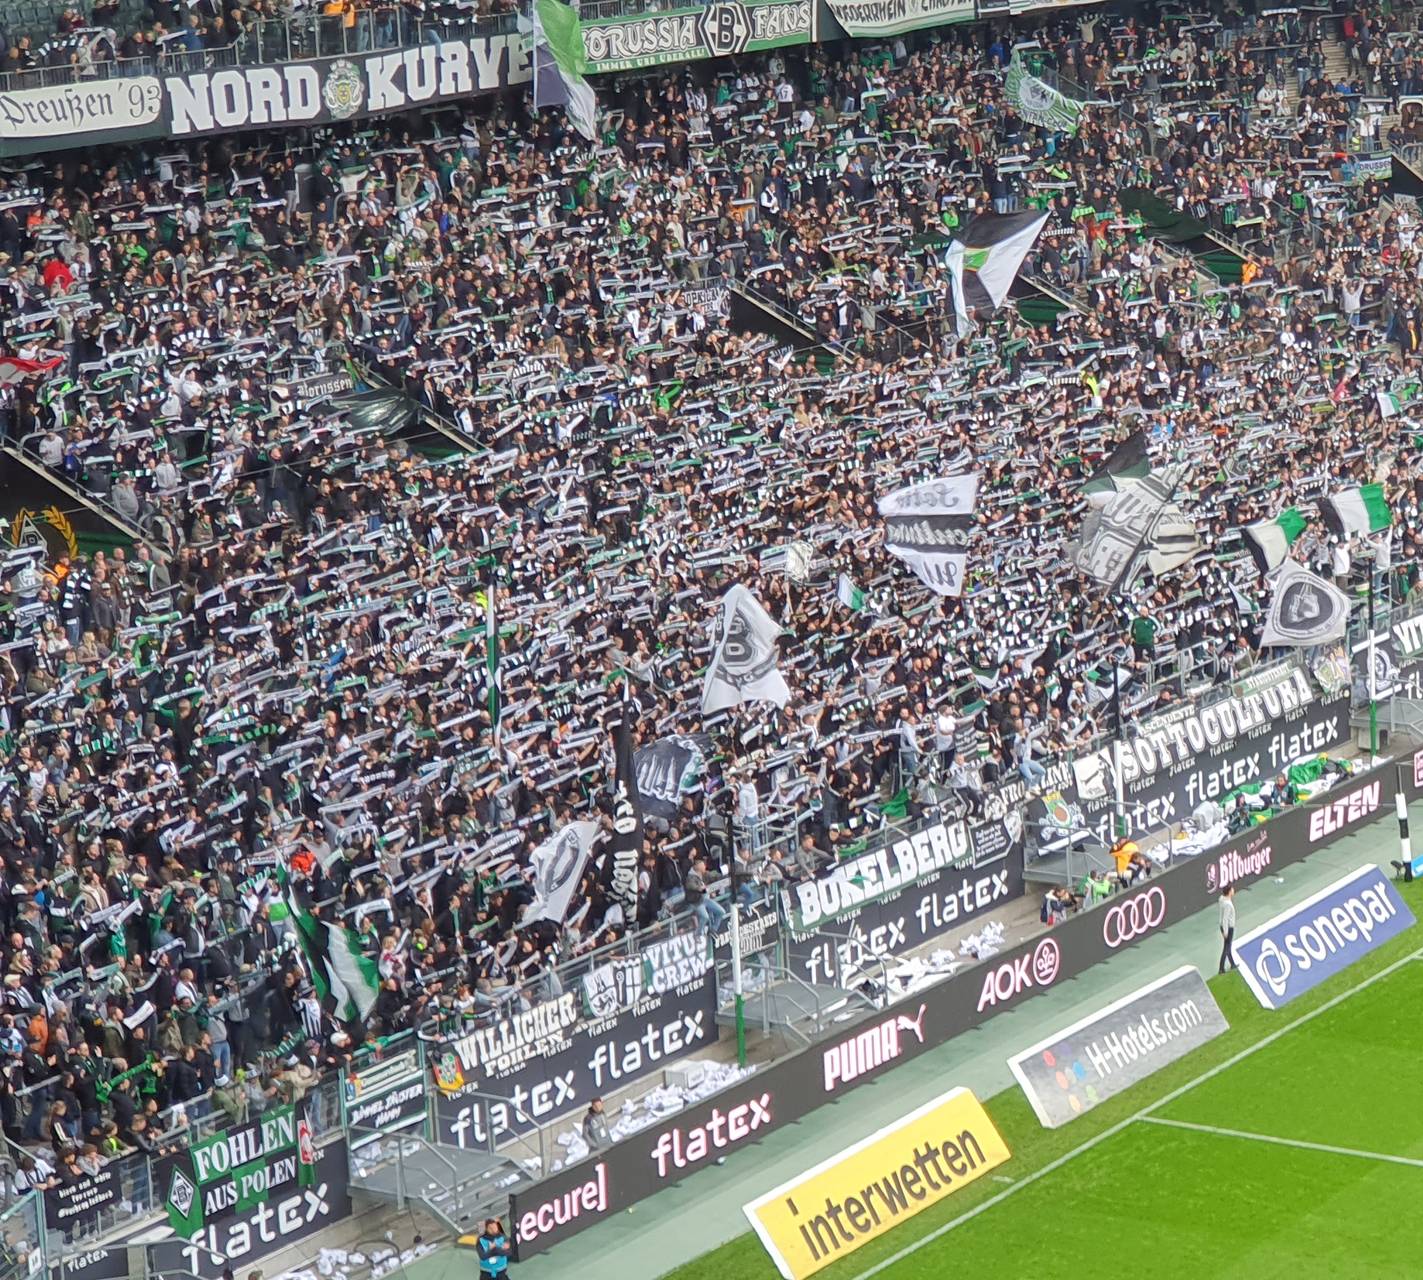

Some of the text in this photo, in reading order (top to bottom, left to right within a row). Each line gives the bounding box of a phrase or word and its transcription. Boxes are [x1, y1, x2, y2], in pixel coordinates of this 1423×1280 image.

[582, 16, 696, 61] ORUSSIA
[753, 3, 811, 38] FANS
[597, 60, 632, 71] IMMER
[1, 89, 113, 130] Preußen
[165, 34, 533, 134] NORD KURVE
[1119, 666, 1314, 785] SOTTOCULTURA
[1268, 716, 1339, 769] flatex
[1185, 752, 1260, 807] flatex
[1309, 780, 1381, 843] ELTEN
[796, 819, 968, 927] BOKELBERG
[1218, 845, 1273, 890] Bitburger
[916, 868, 1010, 935] flatex
[1285, 879, 1397, 972] sonepar
[646, 932, 708, 970] VITUS
[651, 951, 709, 994] CREW
[976, 954, 1034, 1012] AOK
[451, 991, 577, 1071] WILLICHER
[484, 1030, 565, 1078] FOHLEN
[587, 1009, 705, 1090] flatex
[822, 1018, 901, 1092] PUMA
[1084, 998, 1204, 1081] H-Hotels.com
[193, 1111, 295, 1181] FOHLEN
[651, 1092, 773, 1178] flatex
[204, 1155, 297, 1217] AUS POLEN
[785, 1127, 987, 1263] interwetten
[181, 1182, 330, 1277] flatex
